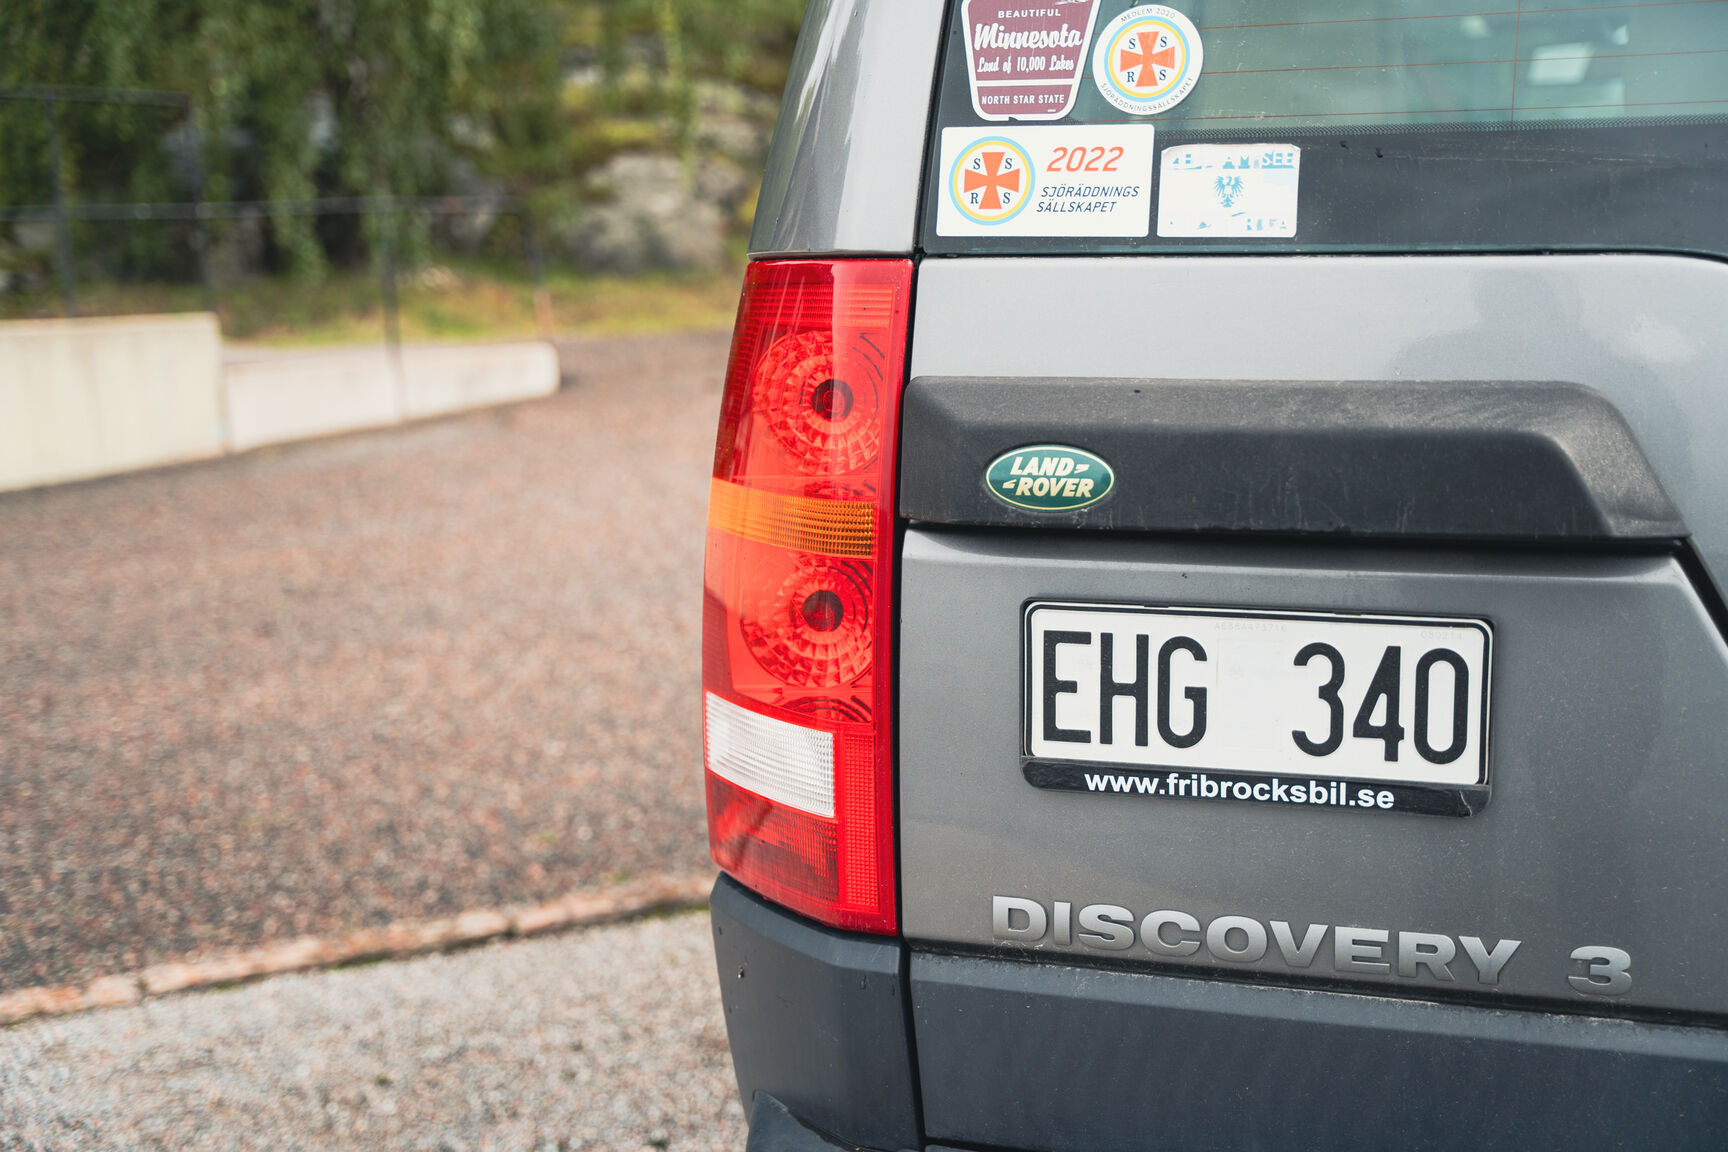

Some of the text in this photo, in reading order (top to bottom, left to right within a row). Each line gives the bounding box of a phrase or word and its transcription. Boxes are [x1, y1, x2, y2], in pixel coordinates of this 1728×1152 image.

[997, 8, 1062, 19] BEAUTIFUL
[1120, 8, 1153, 22] MEDLEM
[974, 23, 1083, 50] Minnesota
[977, 55, 1075, 74] Land of 10,000 Lakes
[981, 94, 1065, 105] NORTH STAR STATE
[1046, 146, 1125, 172] 2022
[1041, 184, 1140, 198] SJÖRÄDDNINGS
[1036, 199, 1117, 213] SÄLLSKAPET
[1010, 457, 1075, 476] LAND
[1015, 477, 1095, 498] ROVER
[1042, 629, 1470, 765] EHG 340
[1084, 773, 1396, 810] www.fribrocksbil.se
[993, 895, 1633, 995] DISCOVERY 3
